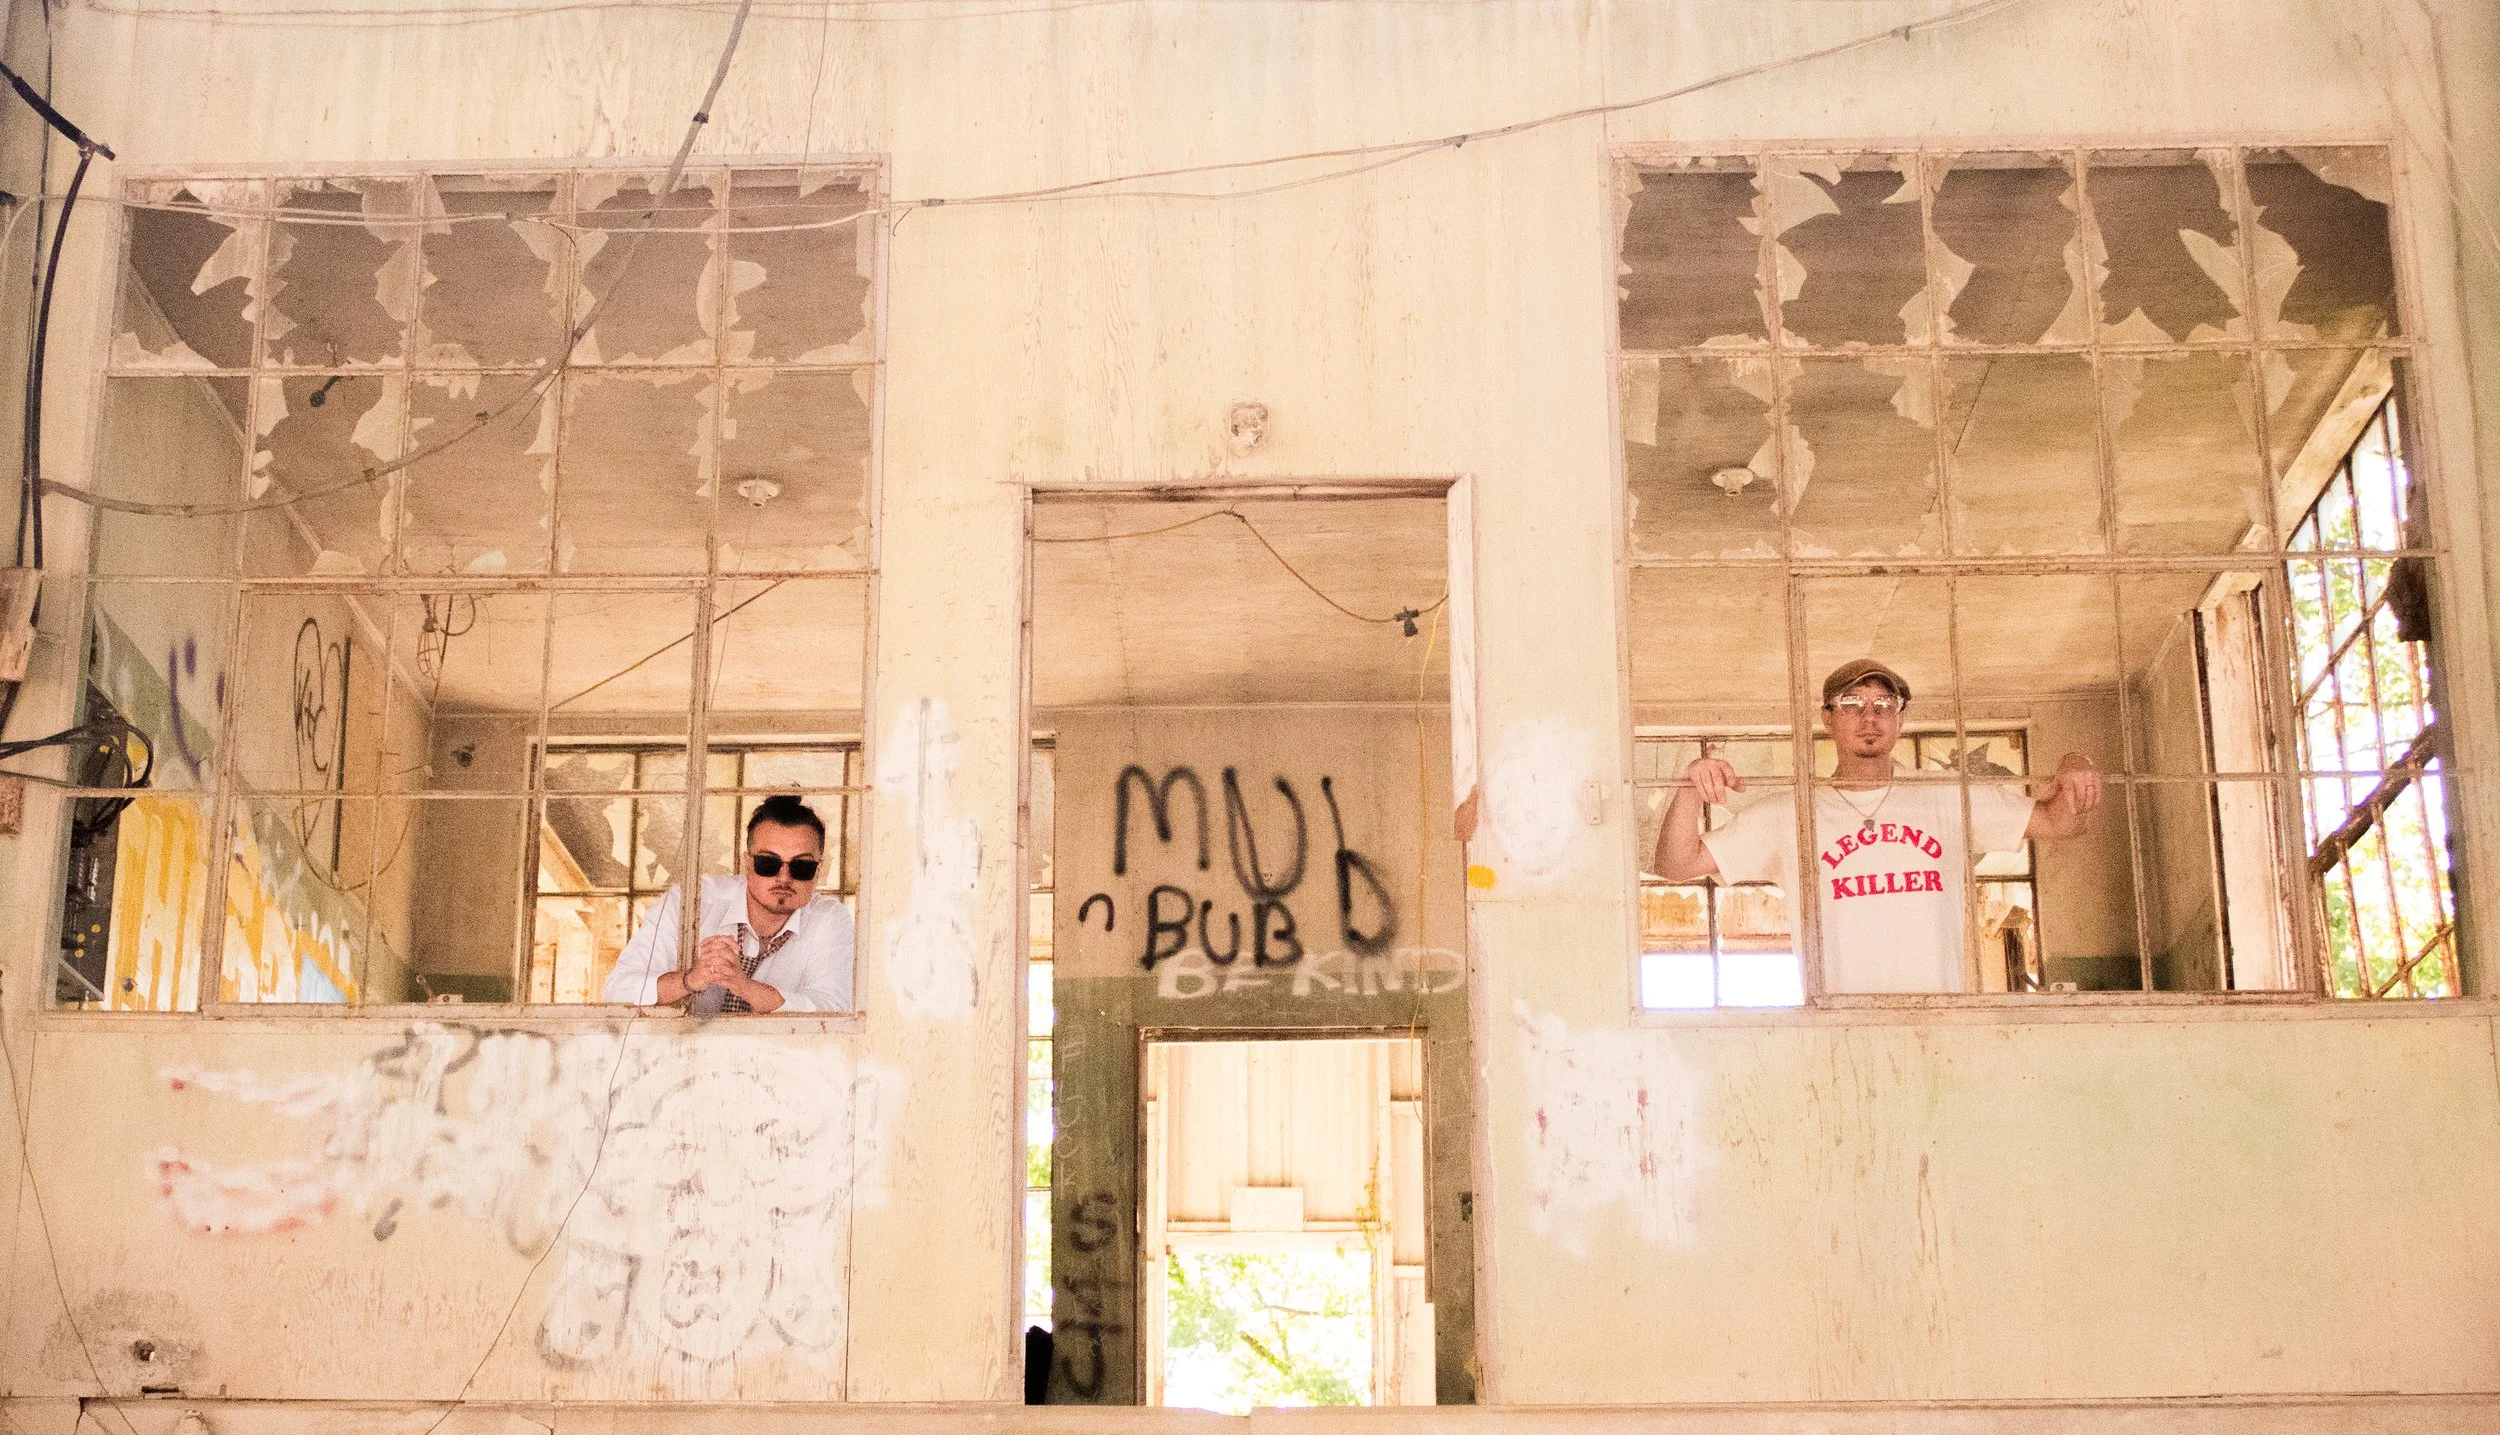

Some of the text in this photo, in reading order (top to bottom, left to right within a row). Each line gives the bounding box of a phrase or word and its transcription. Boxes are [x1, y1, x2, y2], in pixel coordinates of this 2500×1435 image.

[1113, 764, 1400, 956] MUD
[1820, 823, 1943, 870] LEGEND
[1830, 870, 1943, 900] KILLER
[1291, 947, 1467, 997] KIND
